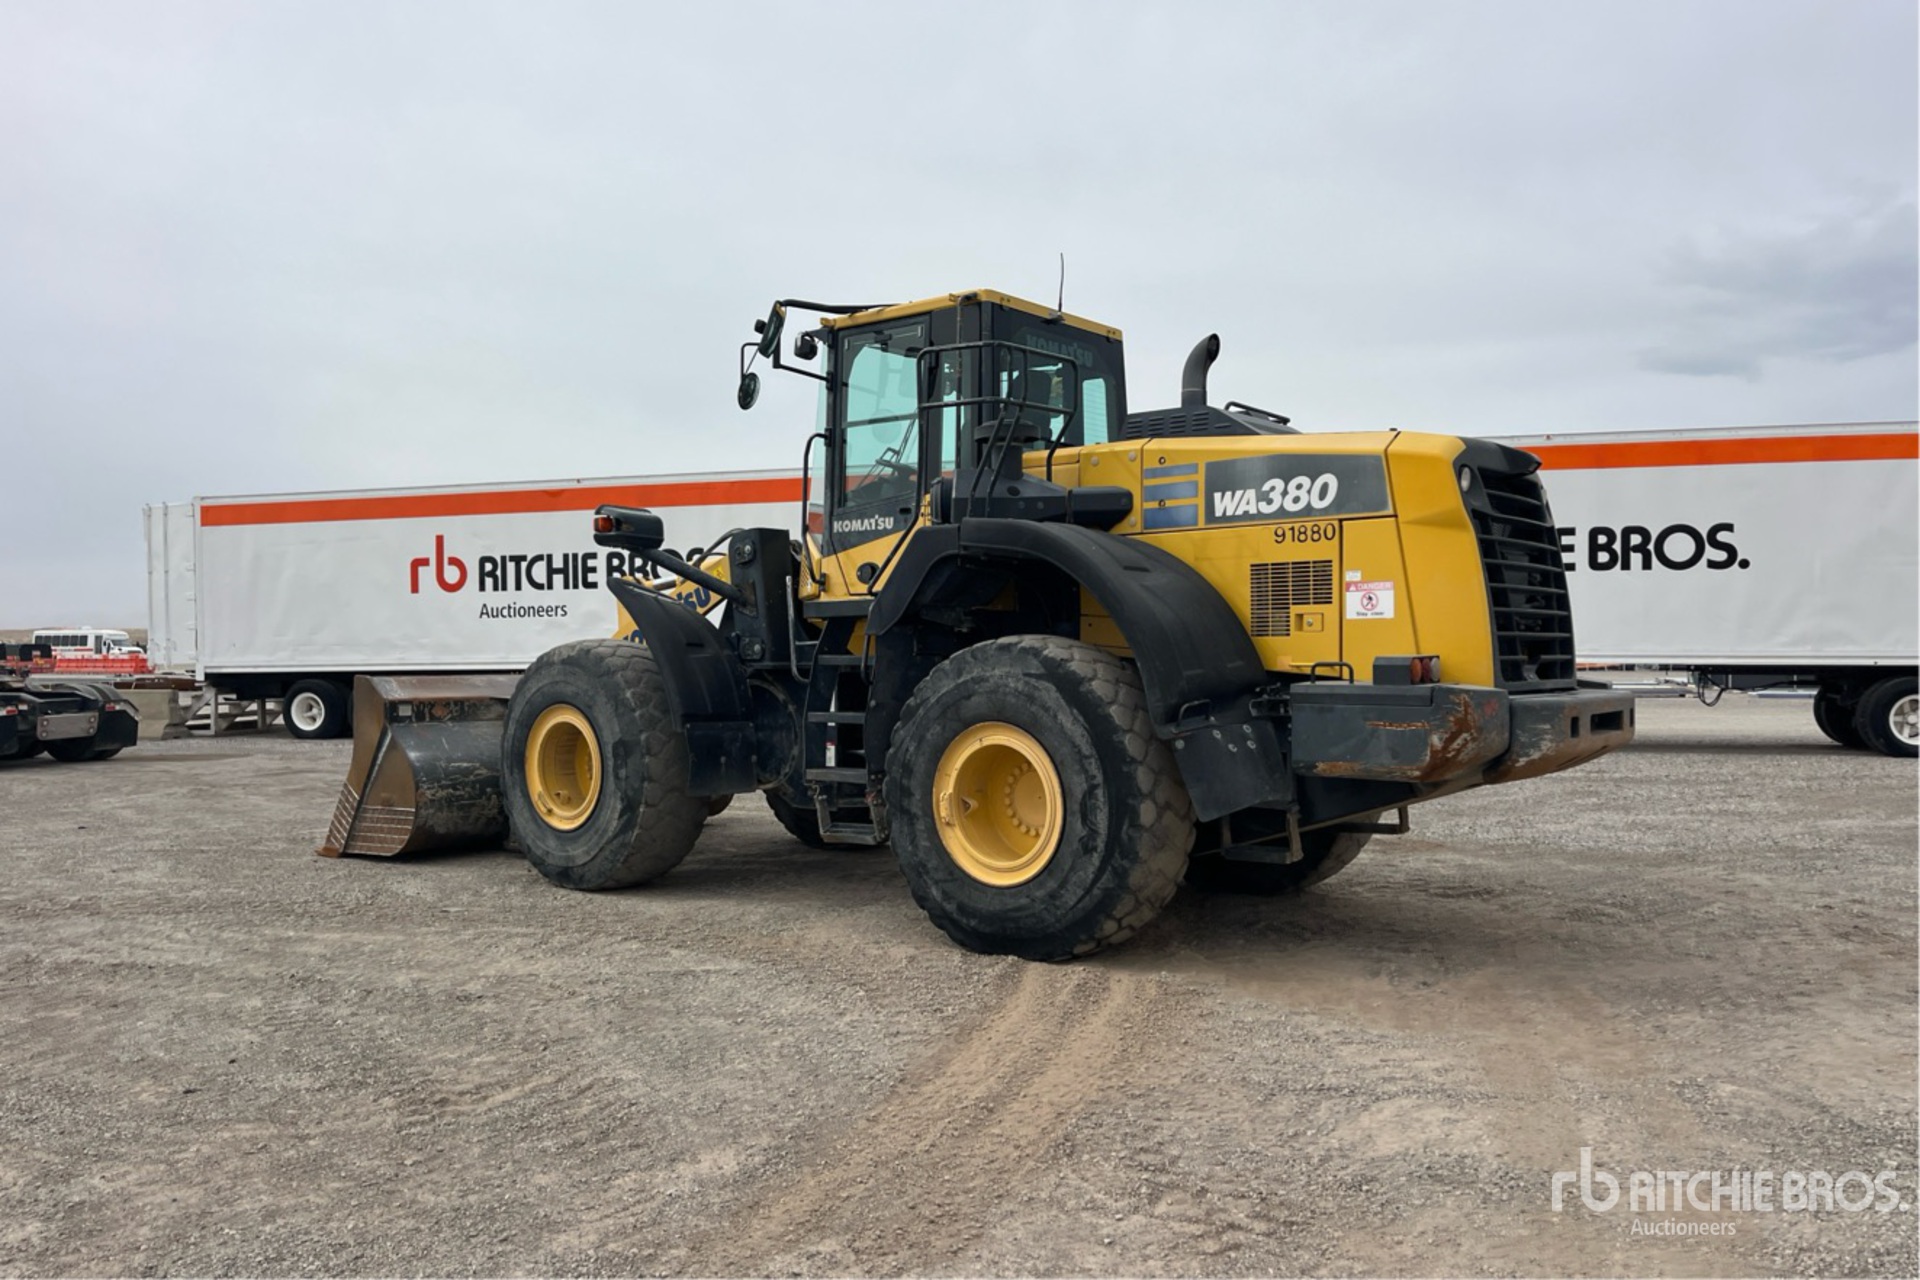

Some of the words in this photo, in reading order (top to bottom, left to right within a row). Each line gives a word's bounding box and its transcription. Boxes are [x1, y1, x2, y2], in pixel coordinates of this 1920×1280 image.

[1213, 473, 1338, 517] WA380
[833, 514, 894, 533] KOMATSU
[1273, 523, 1336, 544] 91880
[1588, 522, 1750, 571] BROS.
[410, 534, 467, 593] rb
[478, 552, 598, 592] RITCHIE
[1357, 582, 1391, 590] DANGER
[479, 603, 568, 619] Auctioneers
